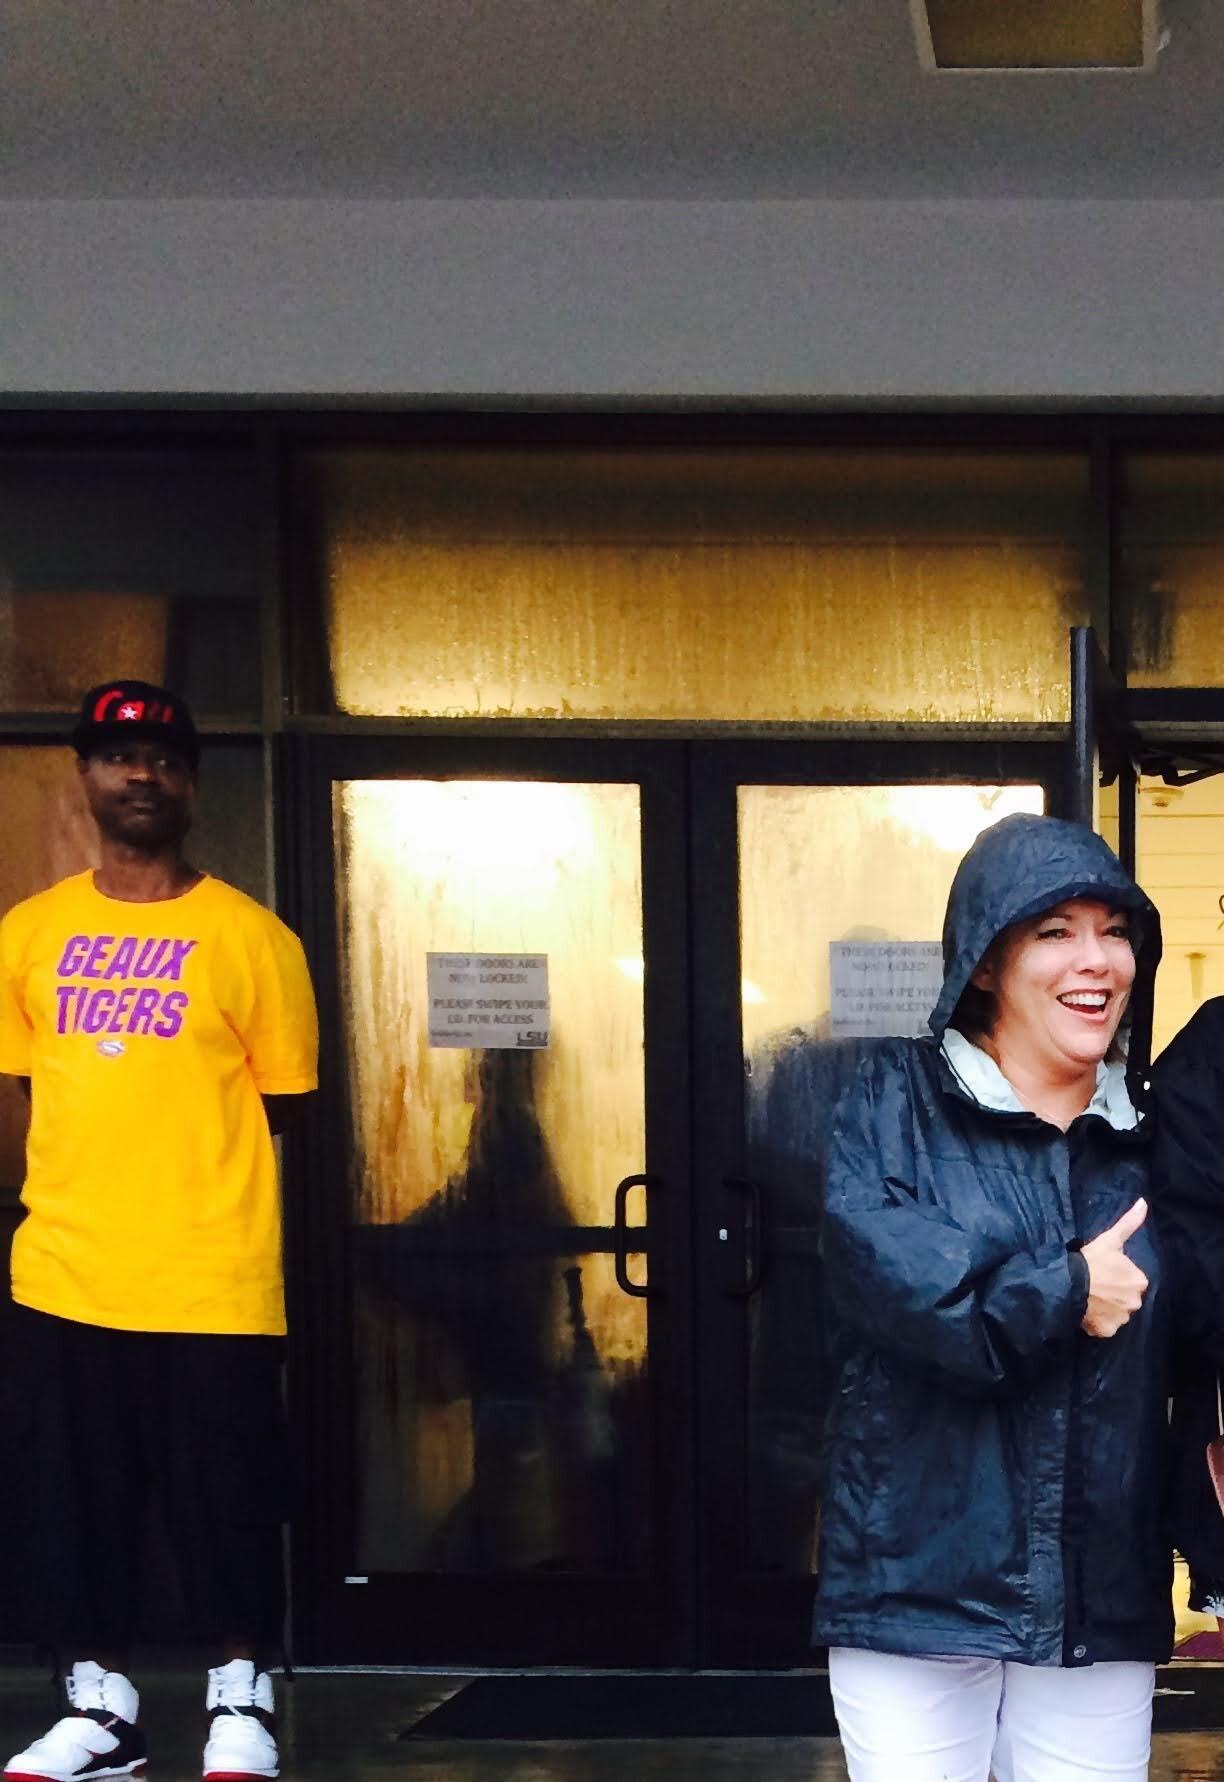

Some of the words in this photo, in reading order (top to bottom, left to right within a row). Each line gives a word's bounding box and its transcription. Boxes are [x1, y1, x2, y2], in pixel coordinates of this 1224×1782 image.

[55, 935, 199, 981] GEAUX
[55, 986, 190, 1039] TIGERS
[493, 1014, 534, 1024] ACCESS
[517, 1030, 549, 1041] LSU
